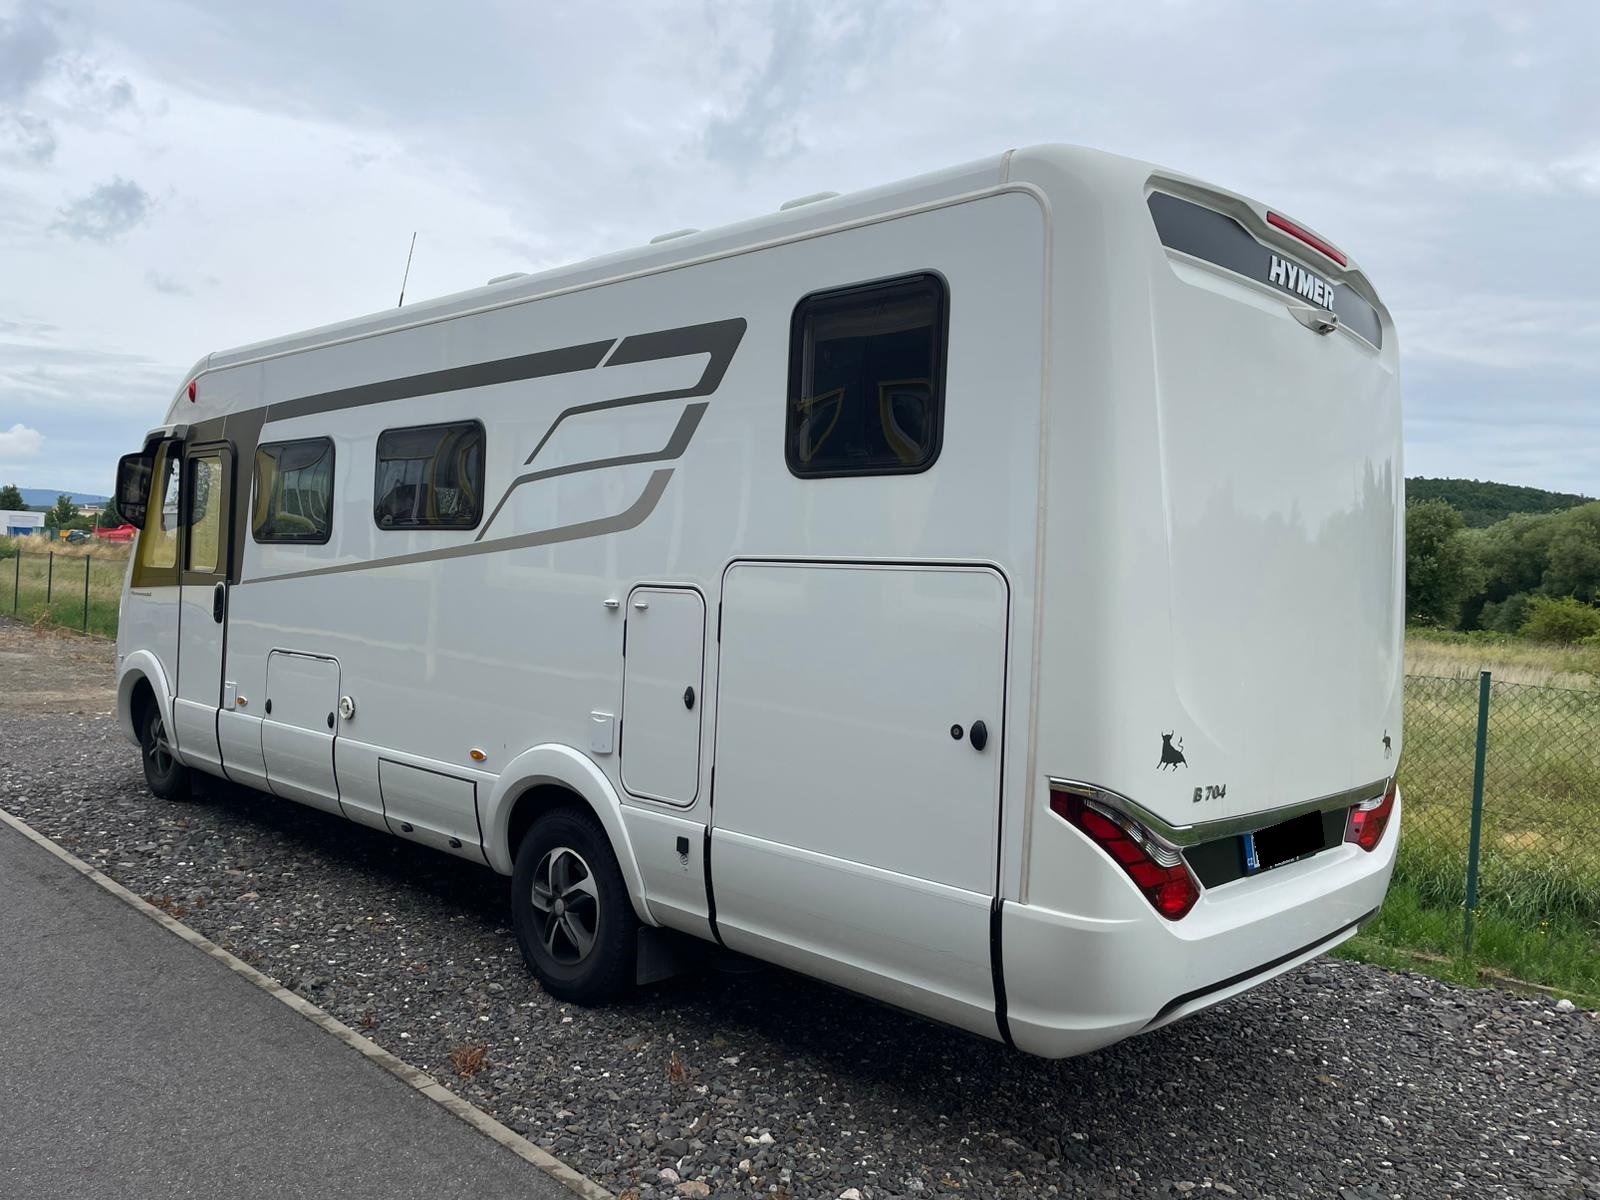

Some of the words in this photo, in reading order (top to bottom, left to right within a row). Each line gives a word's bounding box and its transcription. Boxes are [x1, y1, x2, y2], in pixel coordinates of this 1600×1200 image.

[1269, 255, 1334, 311] HYMER
[1193, 786, 1203, 803] B
[1205, 783, 1226, 801] 704
